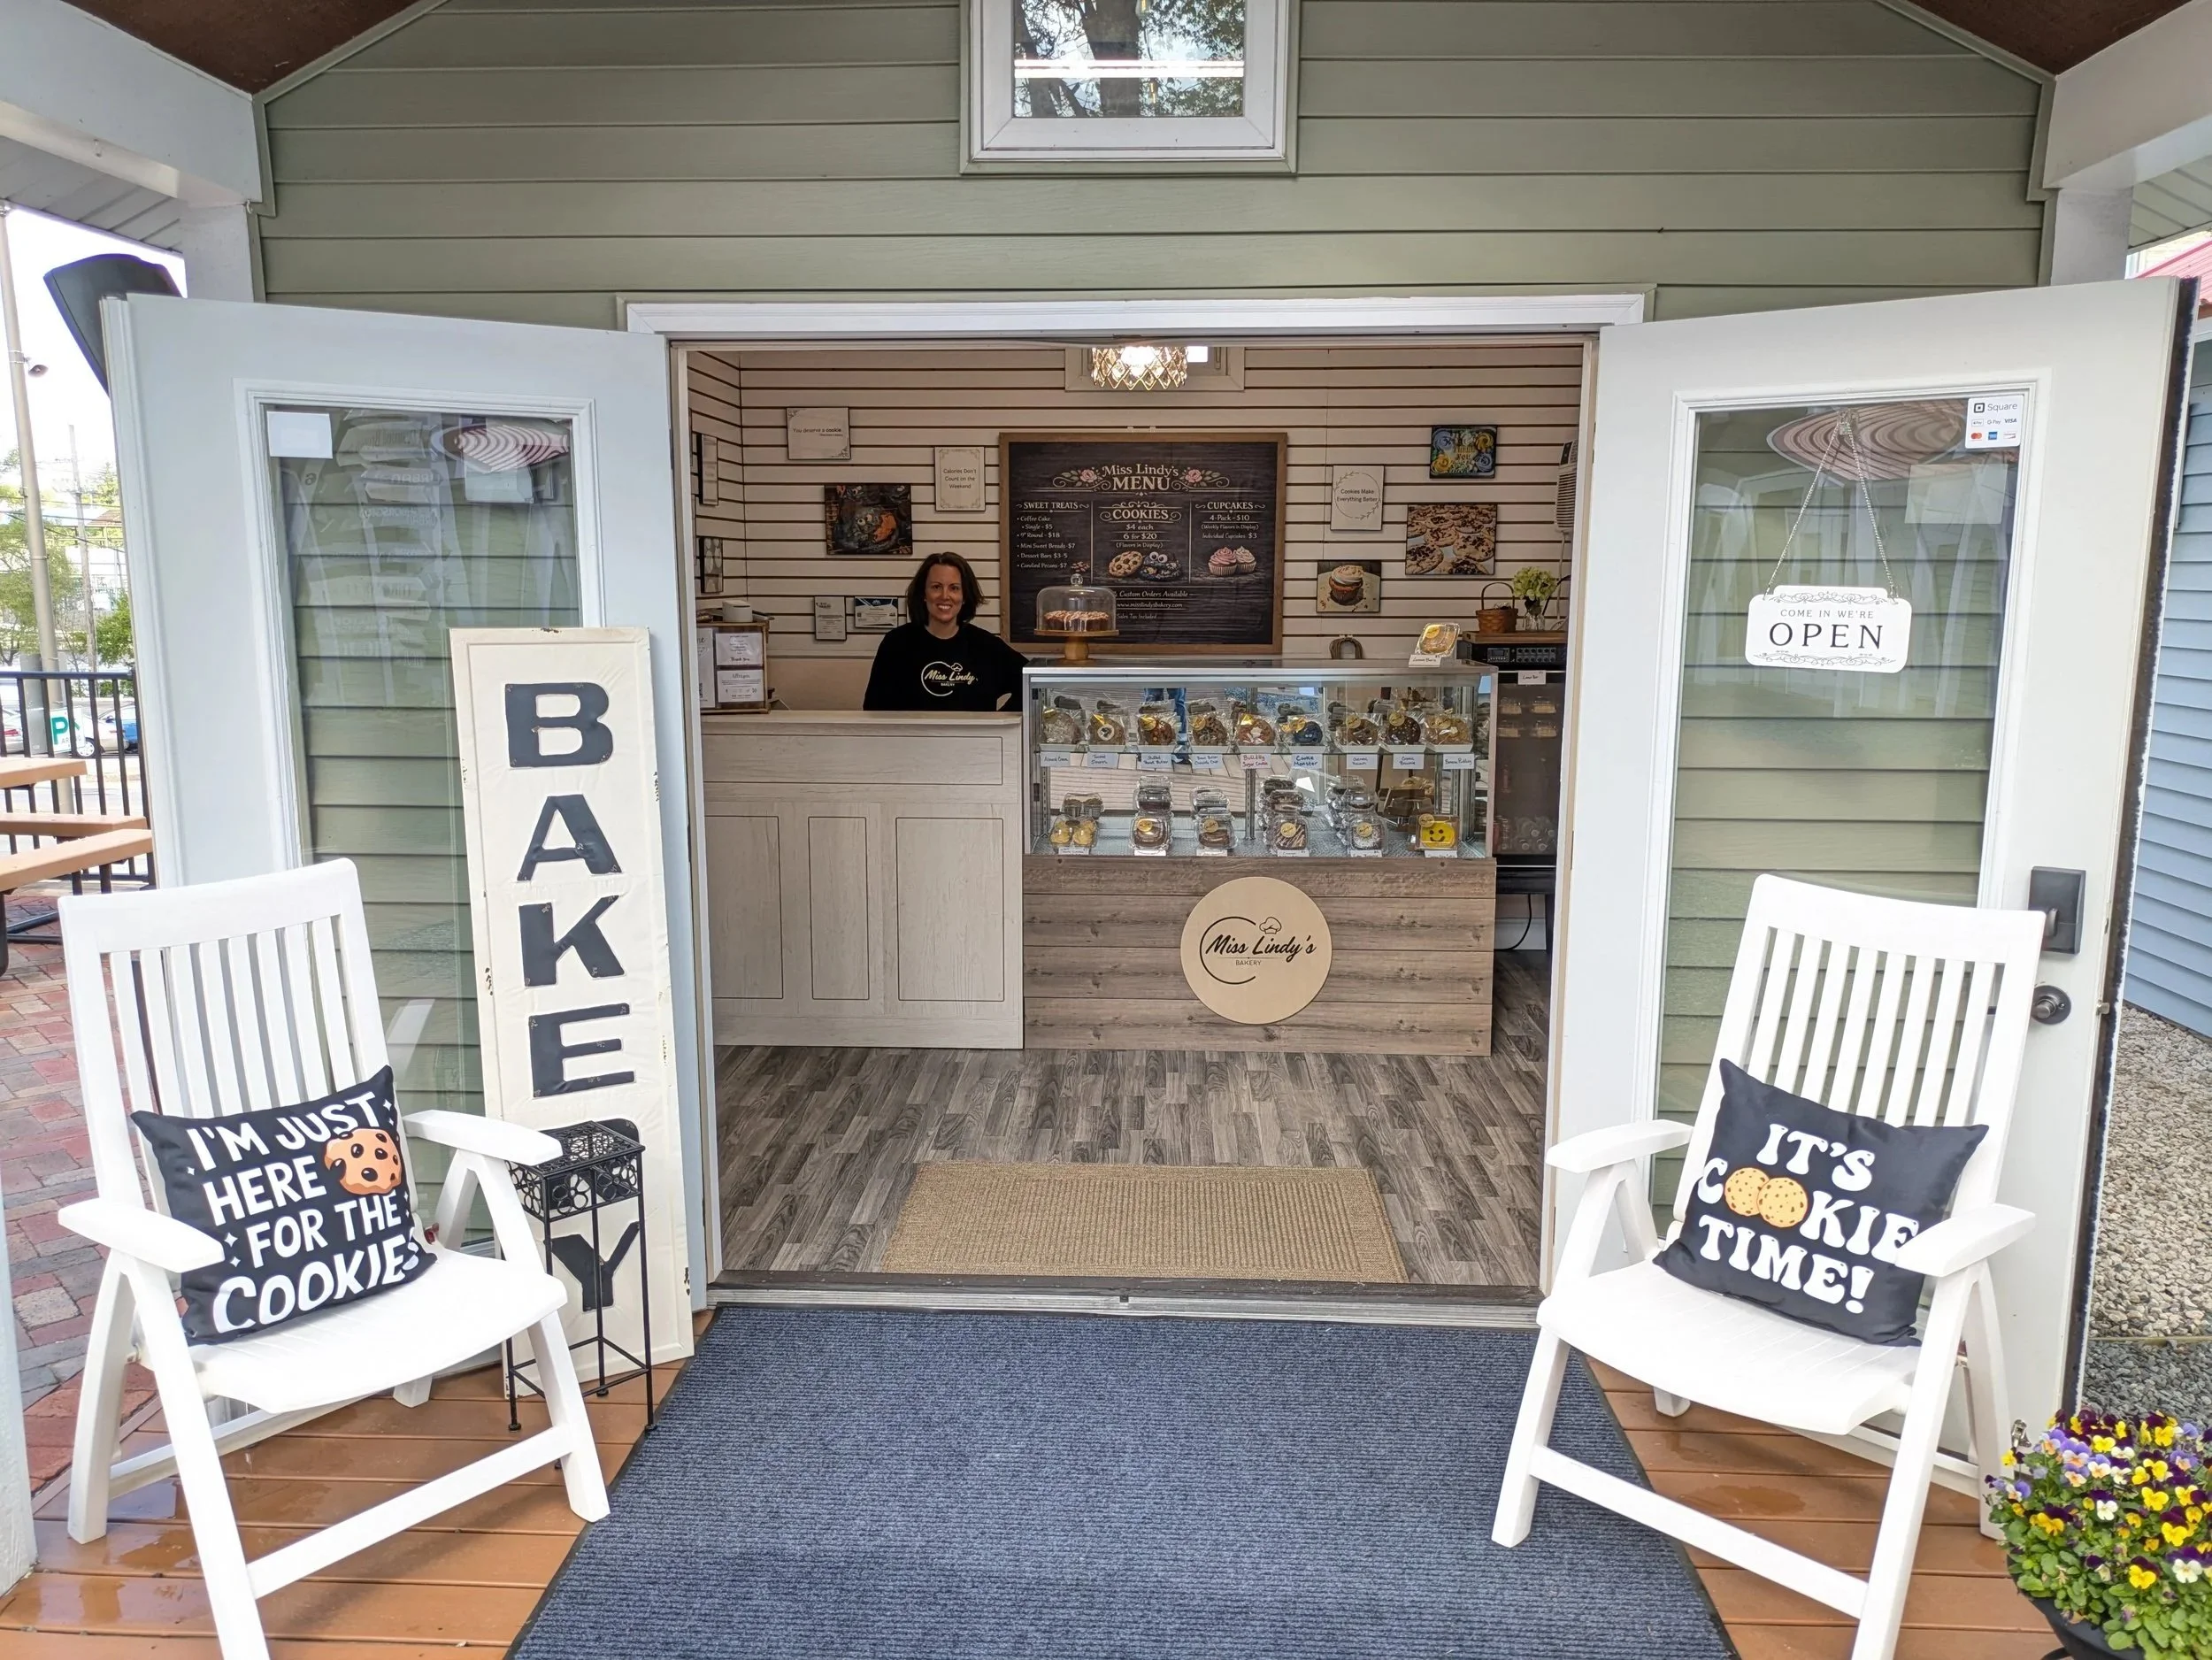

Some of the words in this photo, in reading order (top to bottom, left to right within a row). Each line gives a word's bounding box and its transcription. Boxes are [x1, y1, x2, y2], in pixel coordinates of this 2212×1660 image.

[1987, 403, 2017, 412] Square
[1102, 465, 1133, 477] Miss
[1136, 464, 1179, 478] Lindy's
[1112, 475, 1170, 490] MENU
[1112, 509, 1169, 519] COOKIES
[1780, 609, 1813, 618] COME
[1838, 610, 1874, 619] WE'RE
[1769, 622, 1883, 649] OPEN
[924, 669, 948, 680] Miss
[949, 671, 979, 685] Lindy
[1205, 934, 1249, 955] Miss
[1252, 934, 1317, 963] Lindy's
[187, 1120, 271, 1172] I'M
[274, 1090, 382, 1151] JUST
[1755, 1123, 1876, 1192] IT'S
[202, 1155, 327, 1226] HERE
[245, 1208, 328, 1270] FOR
[334, 1191, 402, 1242] THE
[1698, 1214, 1875, 1314] TIME!
